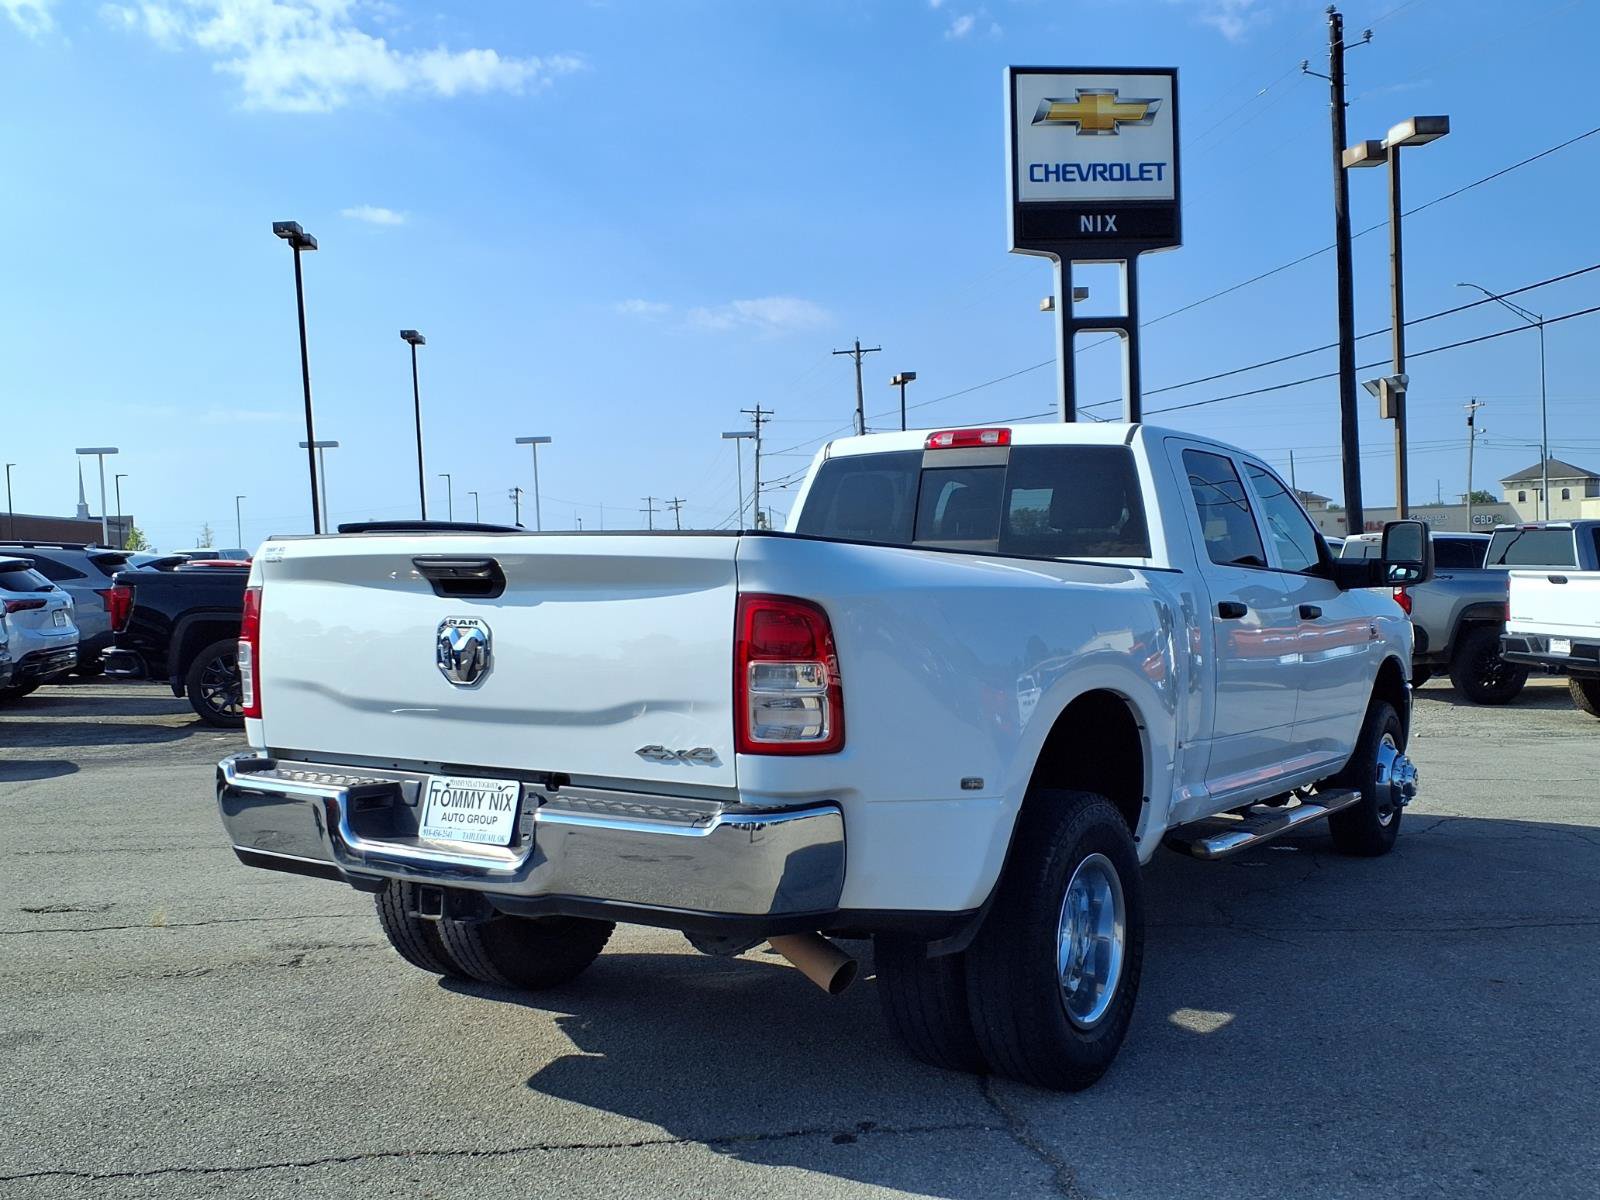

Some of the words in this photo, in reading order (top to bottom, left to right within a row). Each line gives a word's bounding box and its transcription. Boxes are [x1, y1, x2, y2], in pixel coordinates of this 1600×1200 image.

[1029, 162, 1167, 183] CHEVROLET
[1080, 214, 1118, 232] NIX
[1472, 515, 1493, 525] CBD
[448, 618, 479, 626] RAM
[430, 788, 486, 809] TOMMY
[488, 792, 514, 812] NIX
[441, 812, 466, 823] AUTO
[467, 814, 498, 825] GROUP
